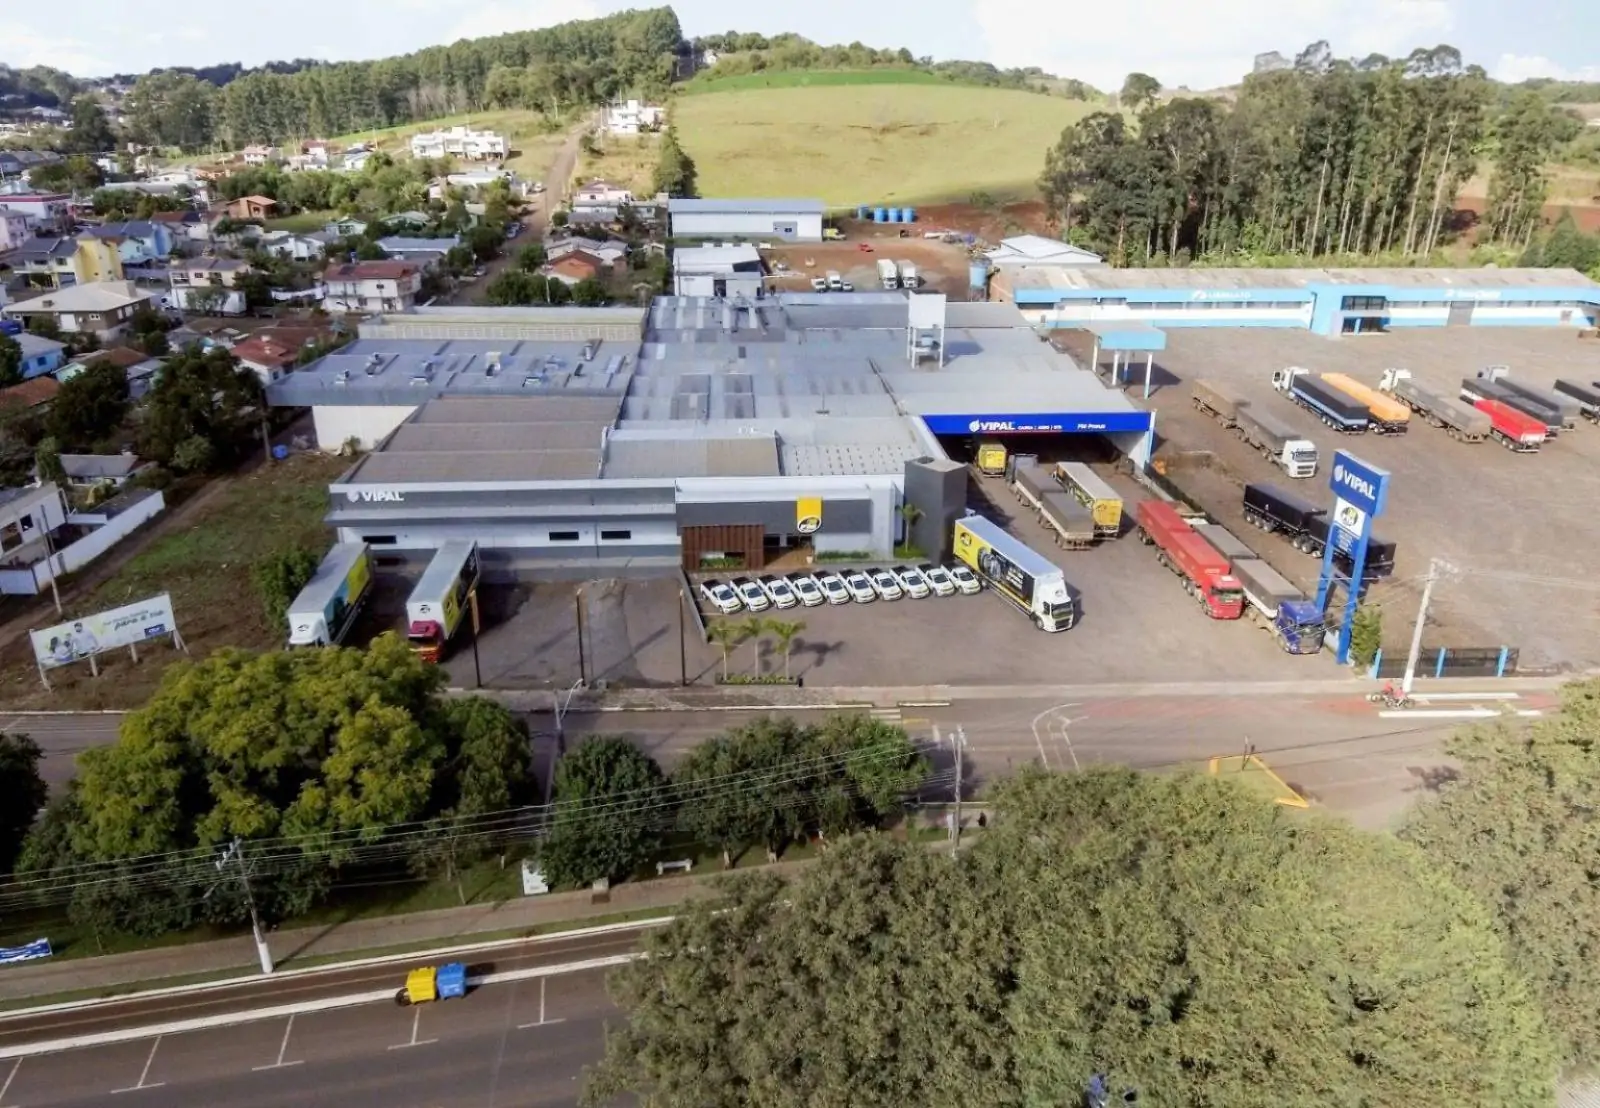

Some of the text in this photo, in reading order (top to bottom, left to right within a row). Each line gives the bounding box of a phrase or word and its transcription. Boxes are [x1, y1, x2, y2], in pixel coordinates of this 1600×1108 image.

[980, 421, 1016, 431] VIPAL
[1344, 469, 1375, 501] VIPAL
[361, 490, 404, 502] VIPAL
